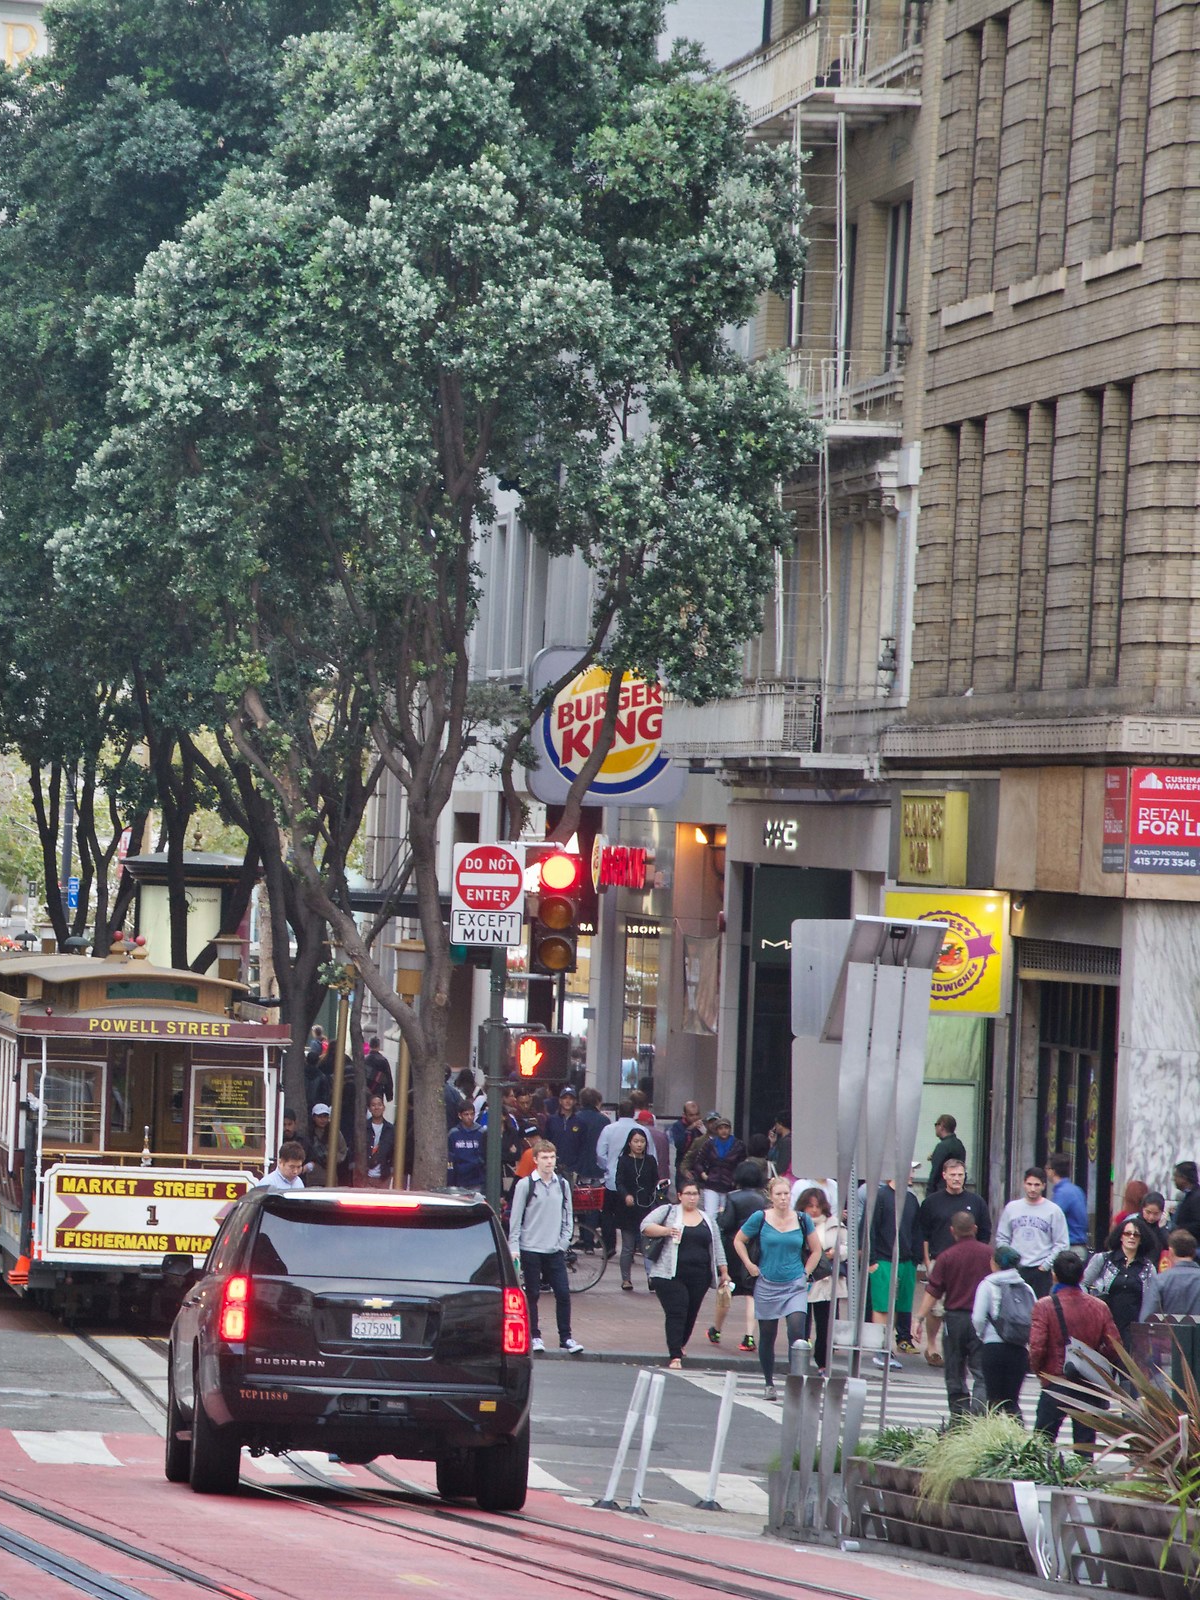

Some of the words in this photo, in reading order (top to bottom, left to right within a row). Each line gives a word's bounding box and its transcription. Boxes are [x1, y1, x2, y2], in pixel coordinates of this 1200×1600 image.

[558, 683, 662, 730] BURGER
[561, 706, 664, 765] KING
[1139, 807, 1195, 822] RETAIL
[1138, 820, 1179, 836] FOR
[465, 858, 483, 870] DO
[488, 858, 514, 871] NOT
[1133, 857, 1151, 866] 415
[1152, 858, 1170, 867] 773
[1171, 858, 1196, 867] 3546
[466, 889, 510, 901] ENTER
[458, 914, 515, 927] EXCEPT
[463, 929, 510, 942] MUNI
[89, 1019, 159, 1034] POWELL
[166, 1021, 231, 1036] STREET
[62, 1177, 138, 1195] MARKET
[153, 1182, 216, 1198] STREET
[225, 1183, 237, 1198] &
[146, 1205, 159, 1226] 1
[64, 1231, 168, 1250] FISHERMANS
[353, 1322, 399, 1336] 63759N1
[255, 1357, 326, 1368] SUBURBAN
